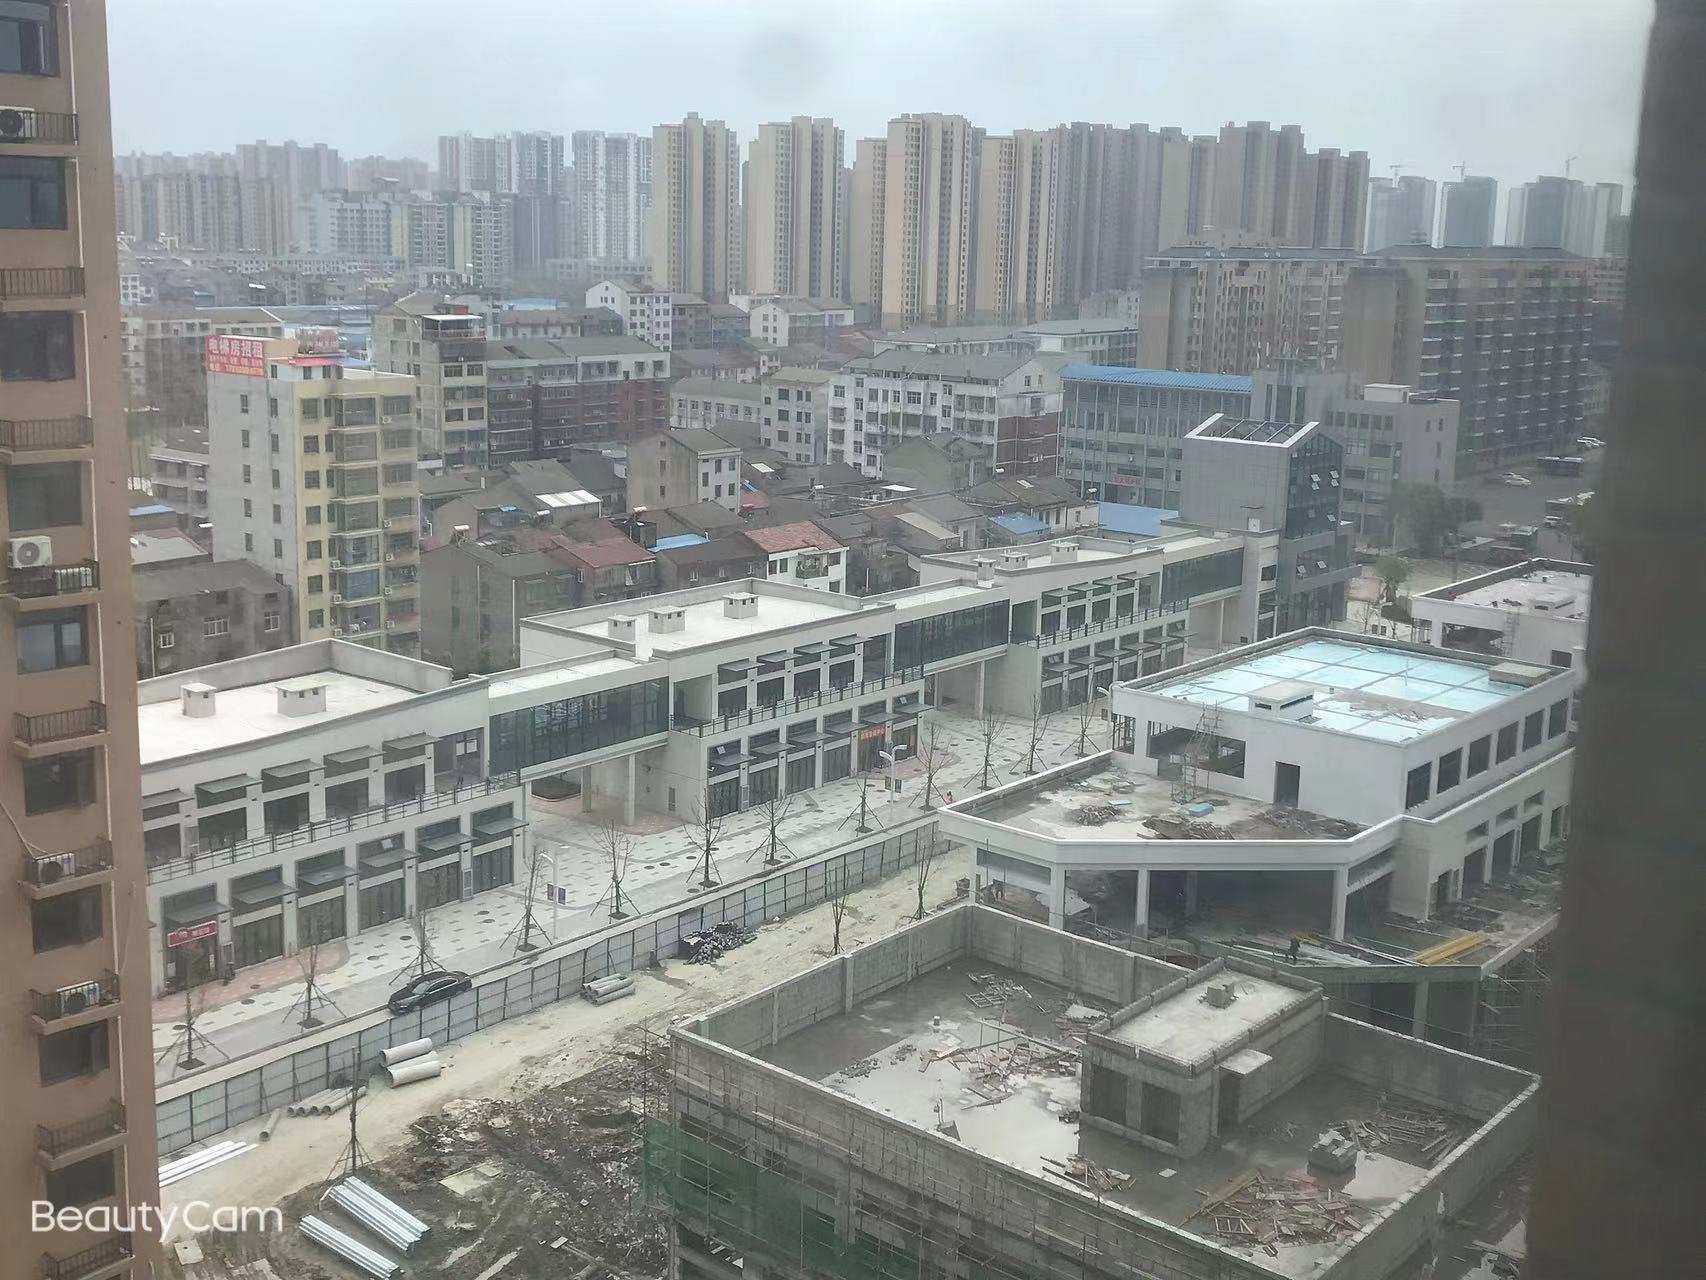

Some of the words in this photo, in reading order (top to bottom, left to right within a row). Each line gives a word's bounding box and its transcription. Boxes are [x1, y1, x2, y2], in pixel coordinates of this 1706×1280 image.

[208, 337, 263, 358] 电梯房招租
